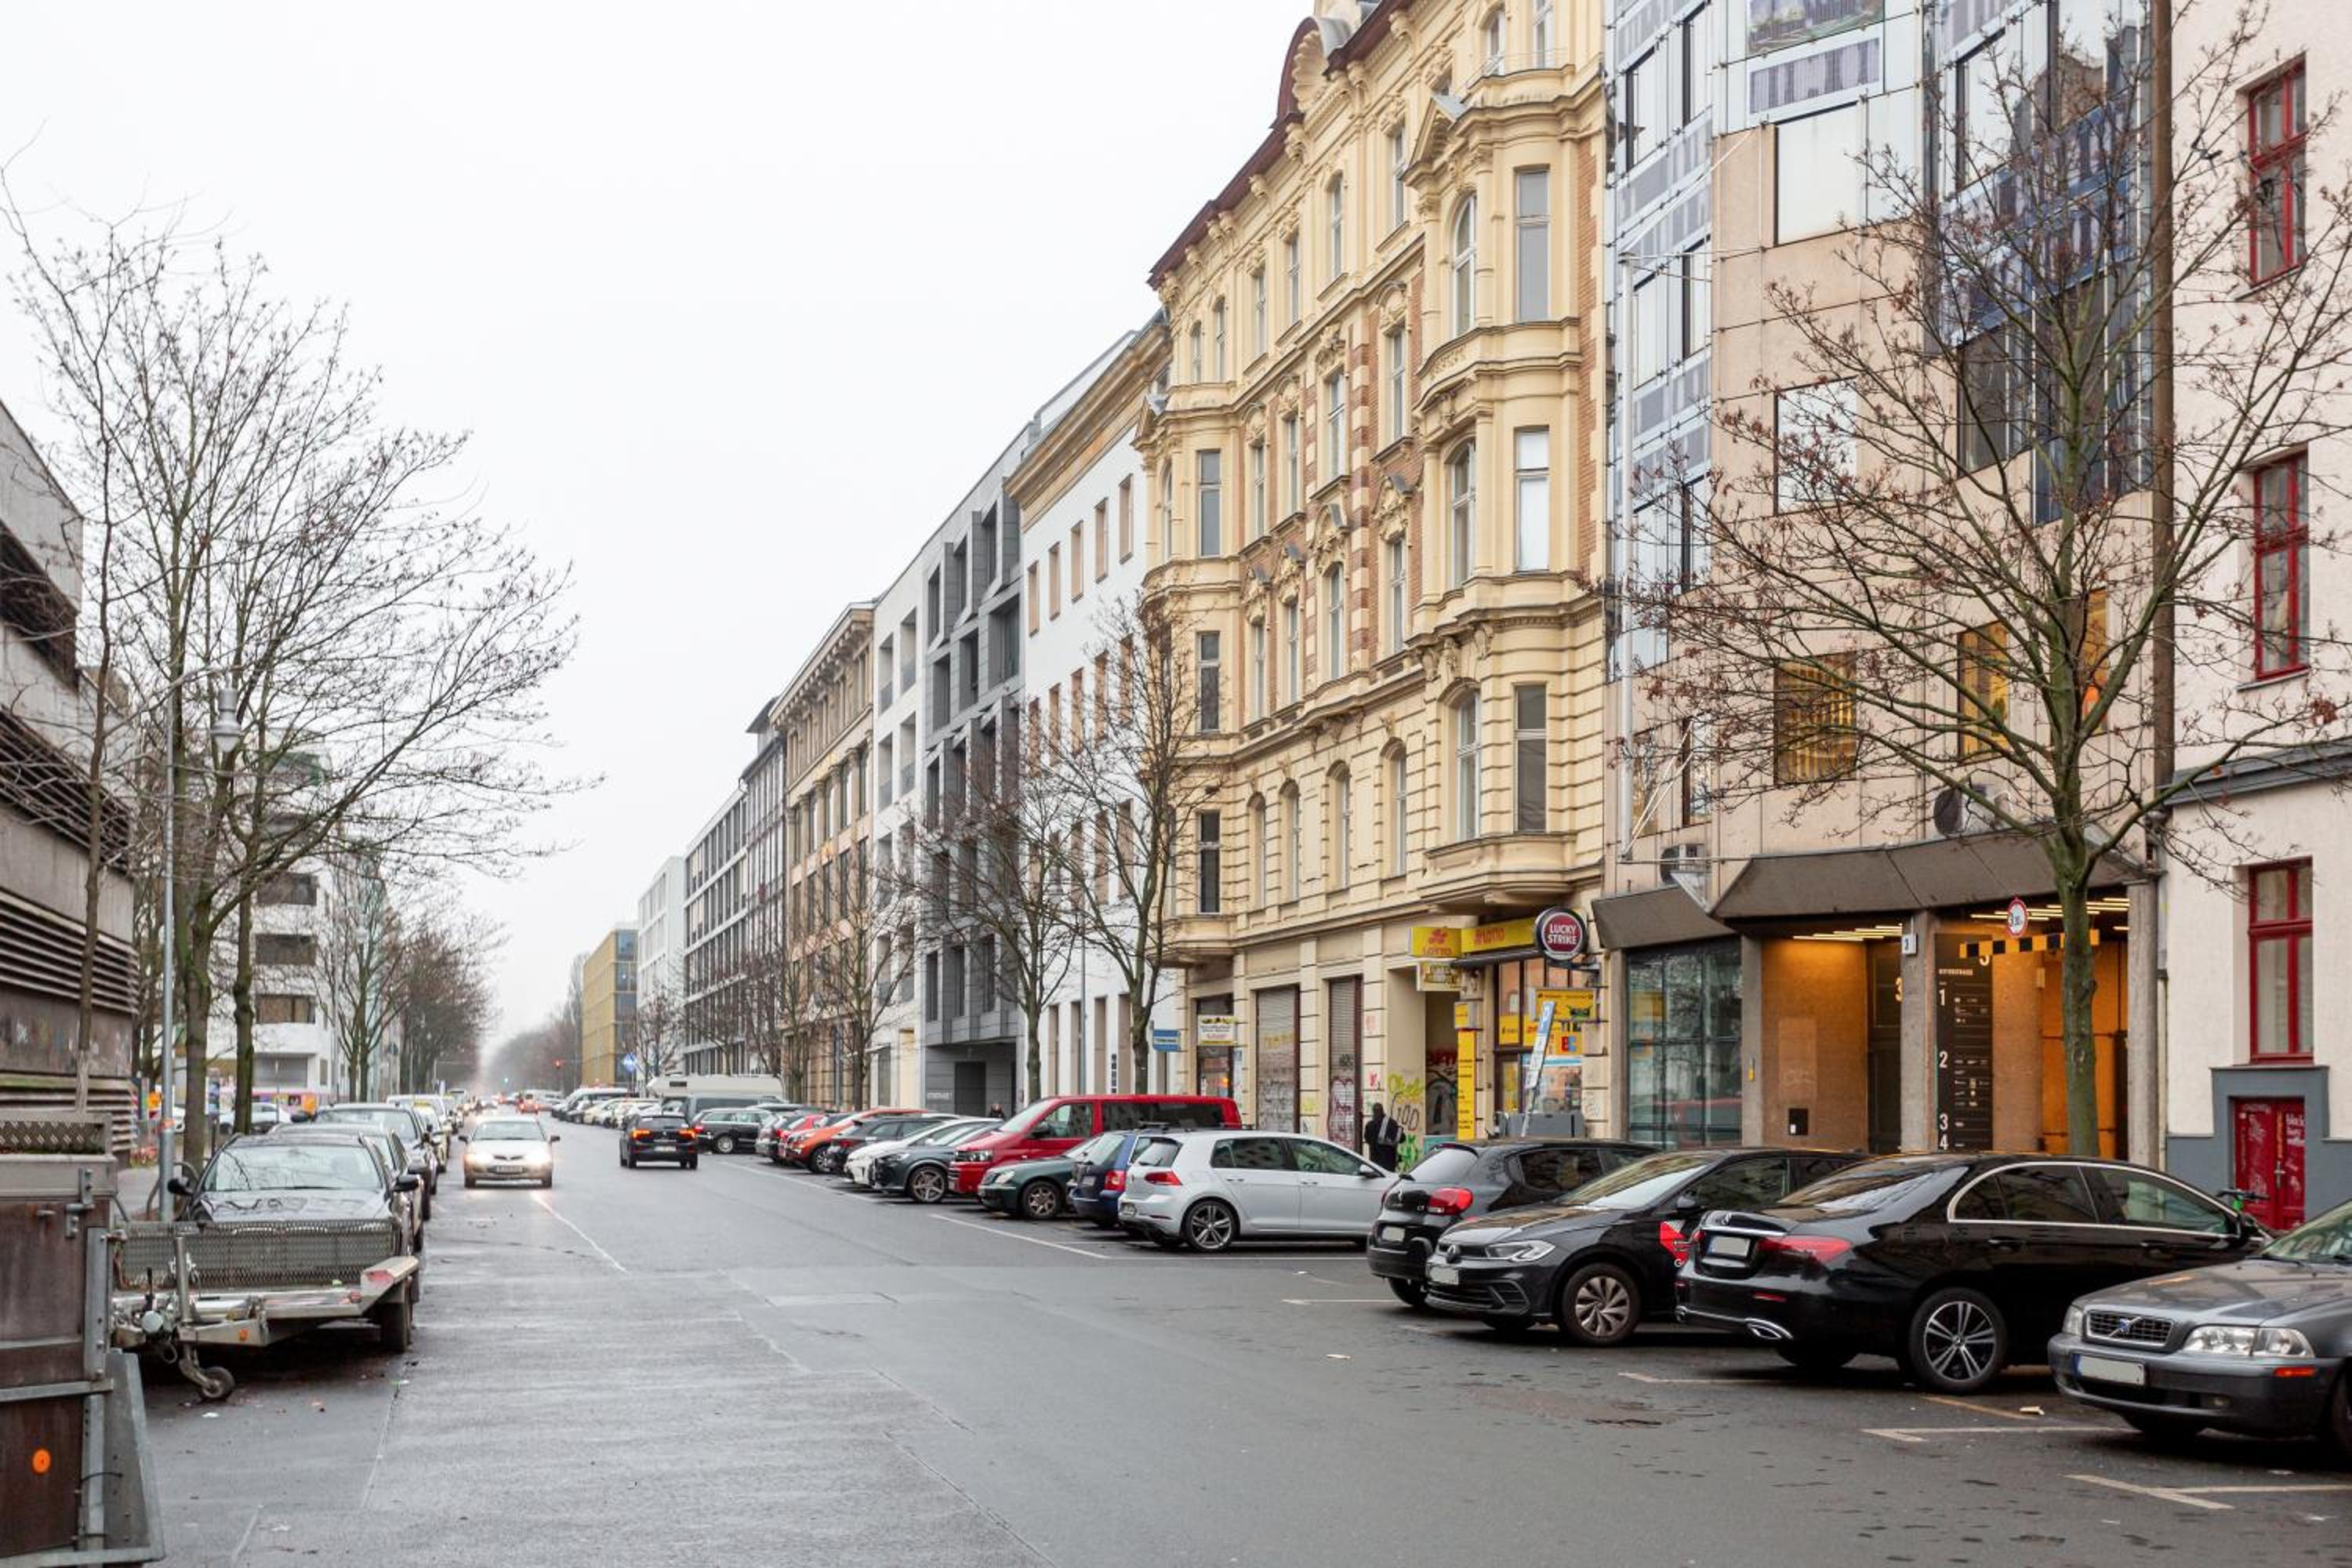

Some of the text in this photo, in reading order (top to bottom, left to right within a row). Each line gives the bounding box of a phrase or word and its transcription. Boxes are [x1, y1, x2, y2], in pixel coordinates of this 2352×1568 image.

[1550, 924, 1576, 934] LUCKY
[1547, 933, 1577, 945] STRIKE
[1940, 989, 1945, 1006] 1
[1939, 1051, 1948, 1069] 2
[1939, 1113, 1948, 1131] 3
[1939, 1134, 1948, 1150] 4
